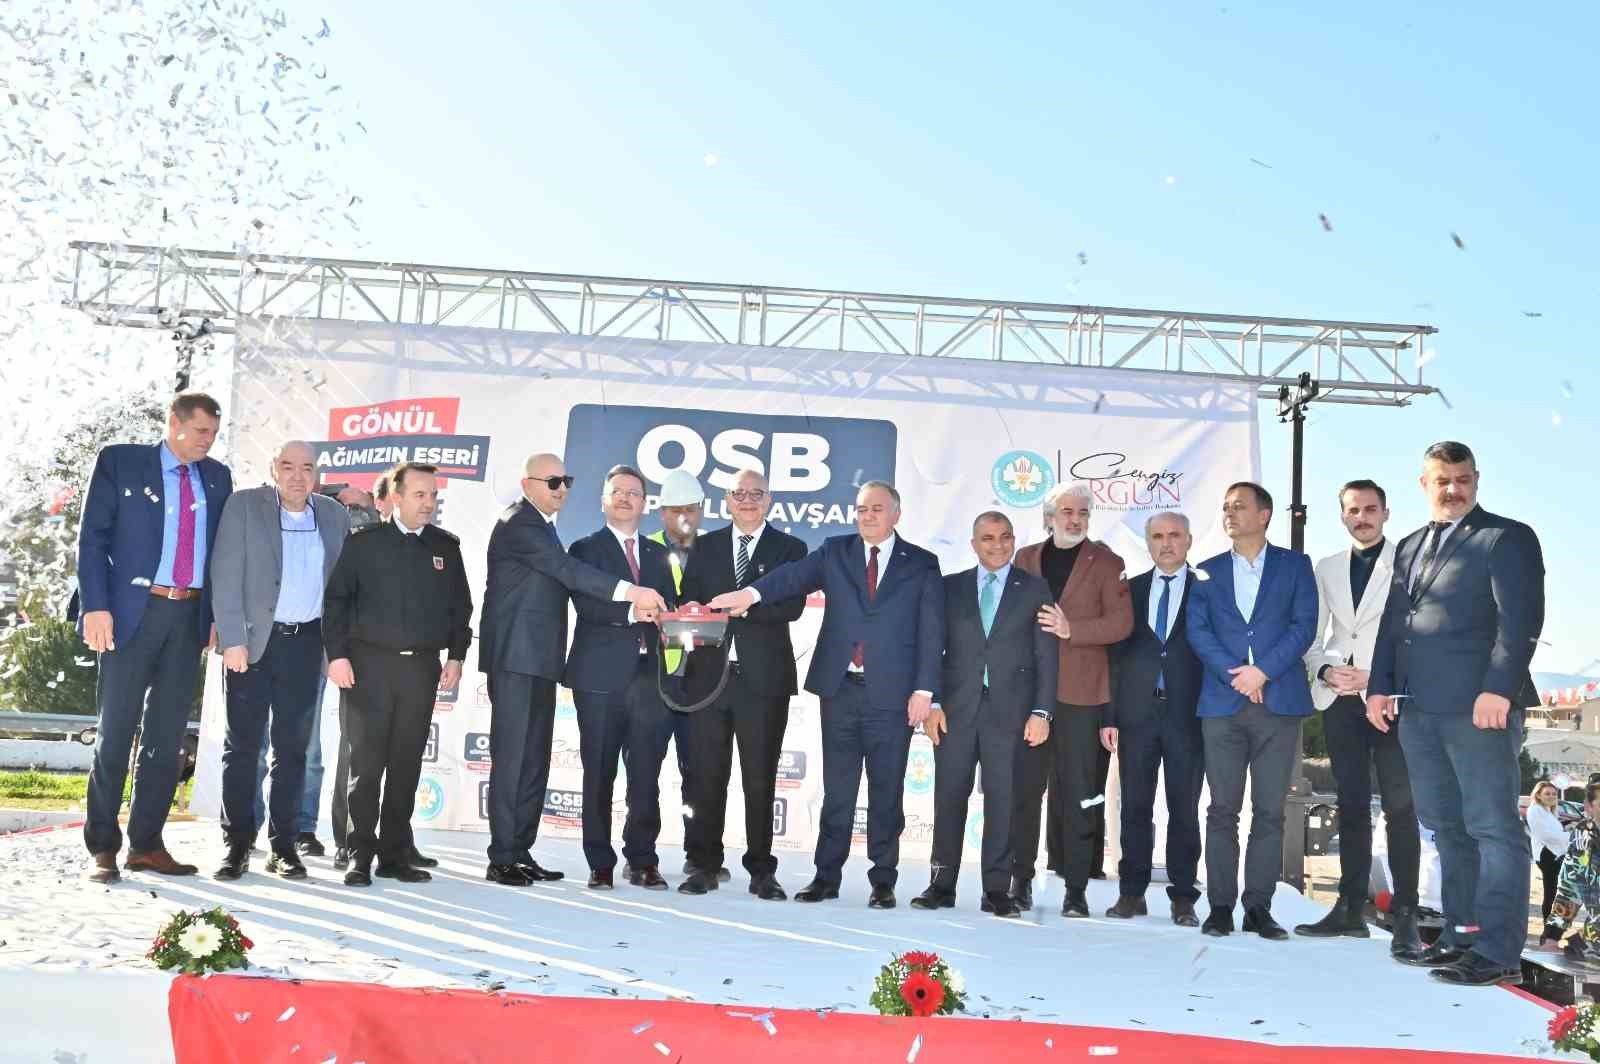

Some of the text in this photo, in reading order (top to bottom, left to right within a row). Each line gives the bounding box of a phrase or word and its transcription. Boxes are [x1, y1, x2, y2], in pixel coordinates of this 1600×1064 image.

[342, 405, 442, 437] GÖNÜL
[316, 444, 479, 467] AĞIMIZIN ESERİ
[637, 424, 831, 492] OSB
[1070, 452, 1184, 491] Cengiz
[1084, 478, 1184, 505] RGÜN
[766, 501, 859, 528] AVŞAK
